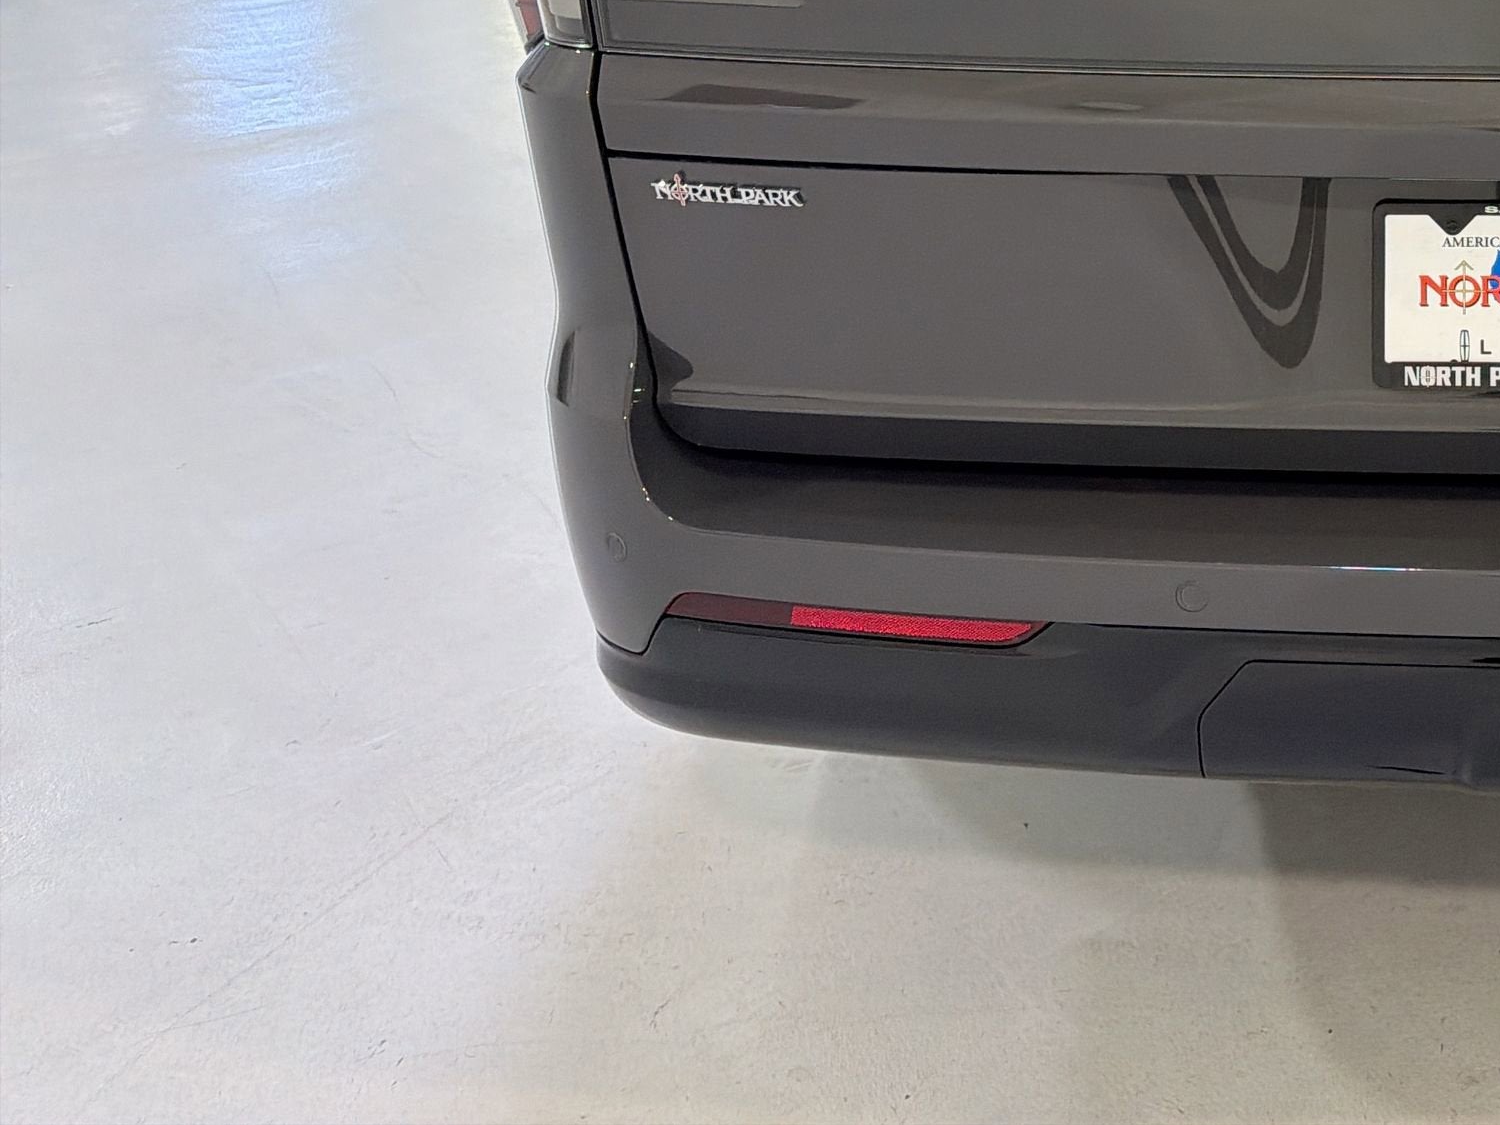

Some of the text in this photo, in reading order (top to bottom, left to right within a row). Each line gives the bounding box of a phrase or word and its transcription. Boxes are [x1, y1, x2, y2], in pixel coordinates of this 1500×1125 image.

[651, 176, 803, 207] NORTH PARK
[1404, 365, 1481, 388] NORTH
